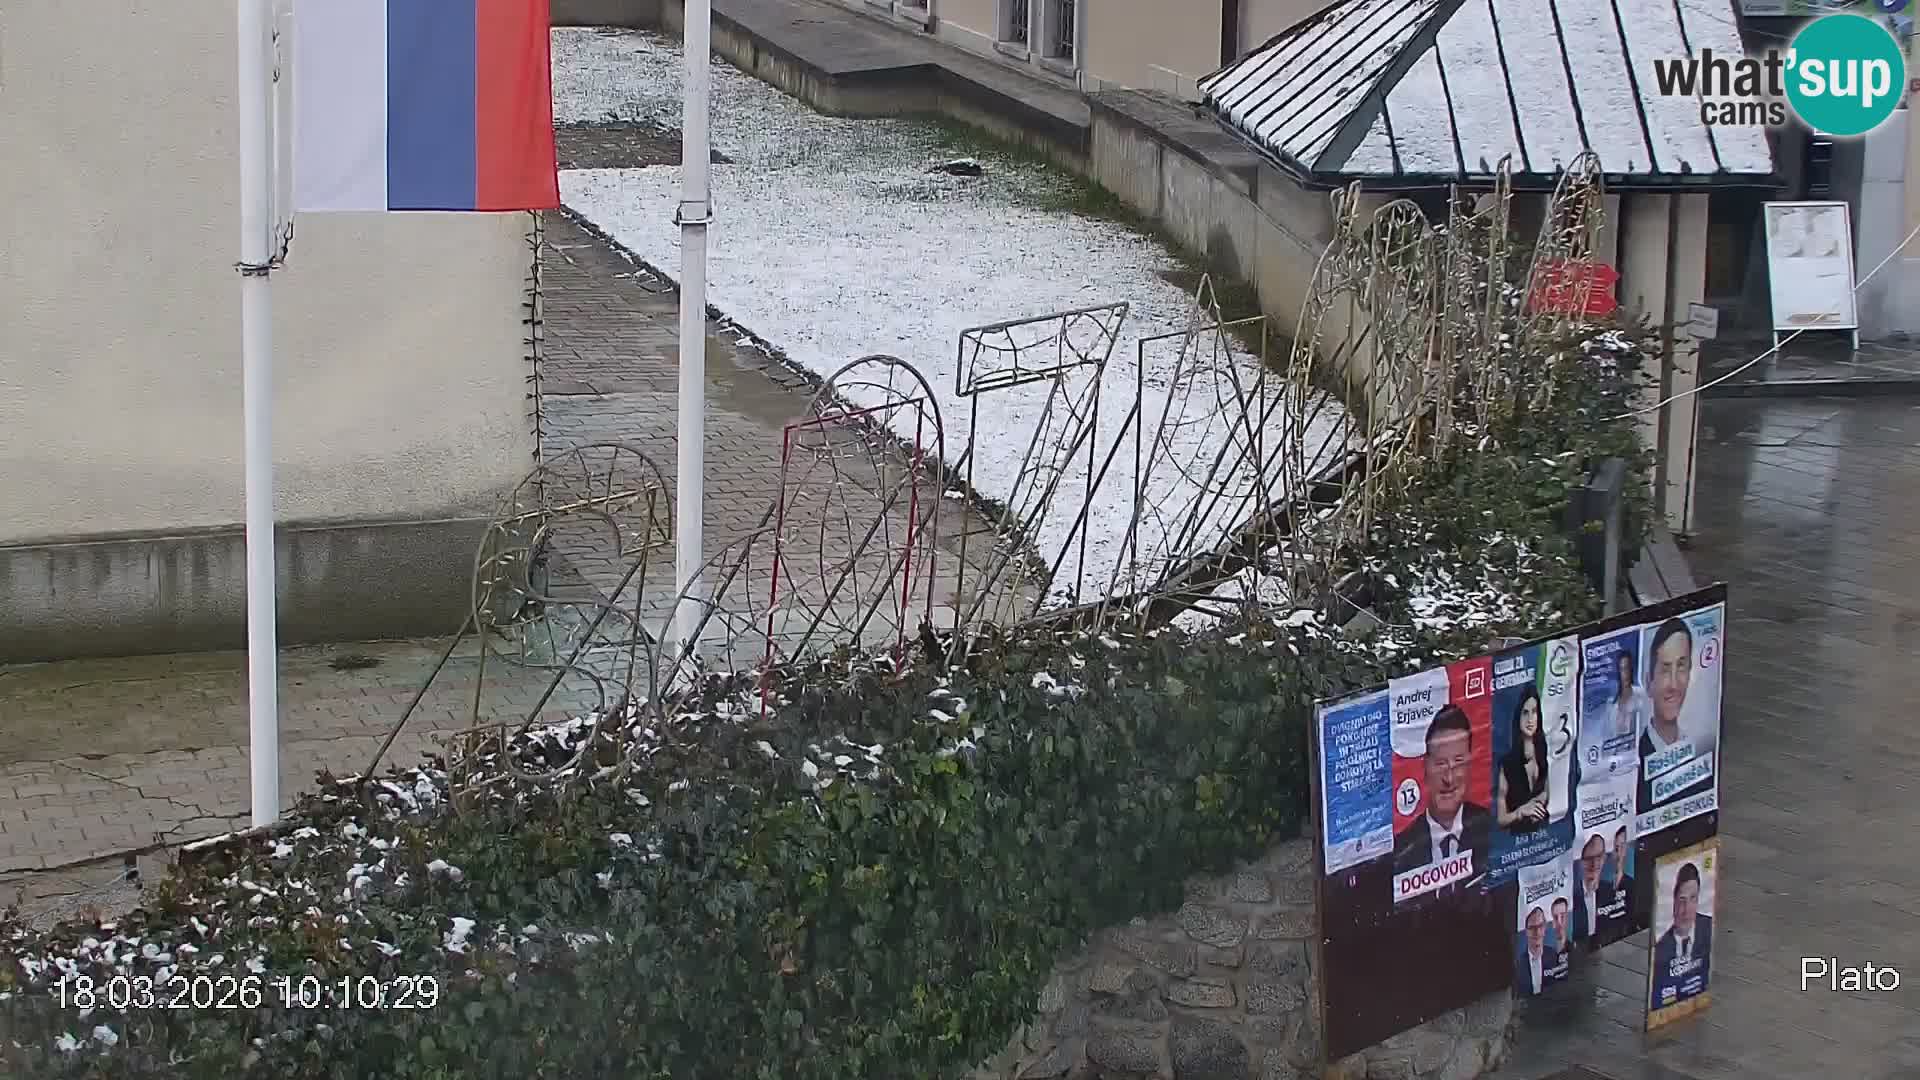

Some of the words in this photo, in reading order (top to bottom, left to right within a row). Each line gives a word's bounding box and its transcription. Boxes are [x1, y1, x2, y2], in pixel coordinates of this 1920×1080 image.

[1396, 685, 1432, 707] Andrej
[1397, 706, 1434, 725] Erjavec
[1555, 712, 1571, 755] 3
[1401, 788, 1416, 806] 13
[1683, 793, 1714, 816] FOKUS
[1401, 857, 1469, 894] DOGOVOR
